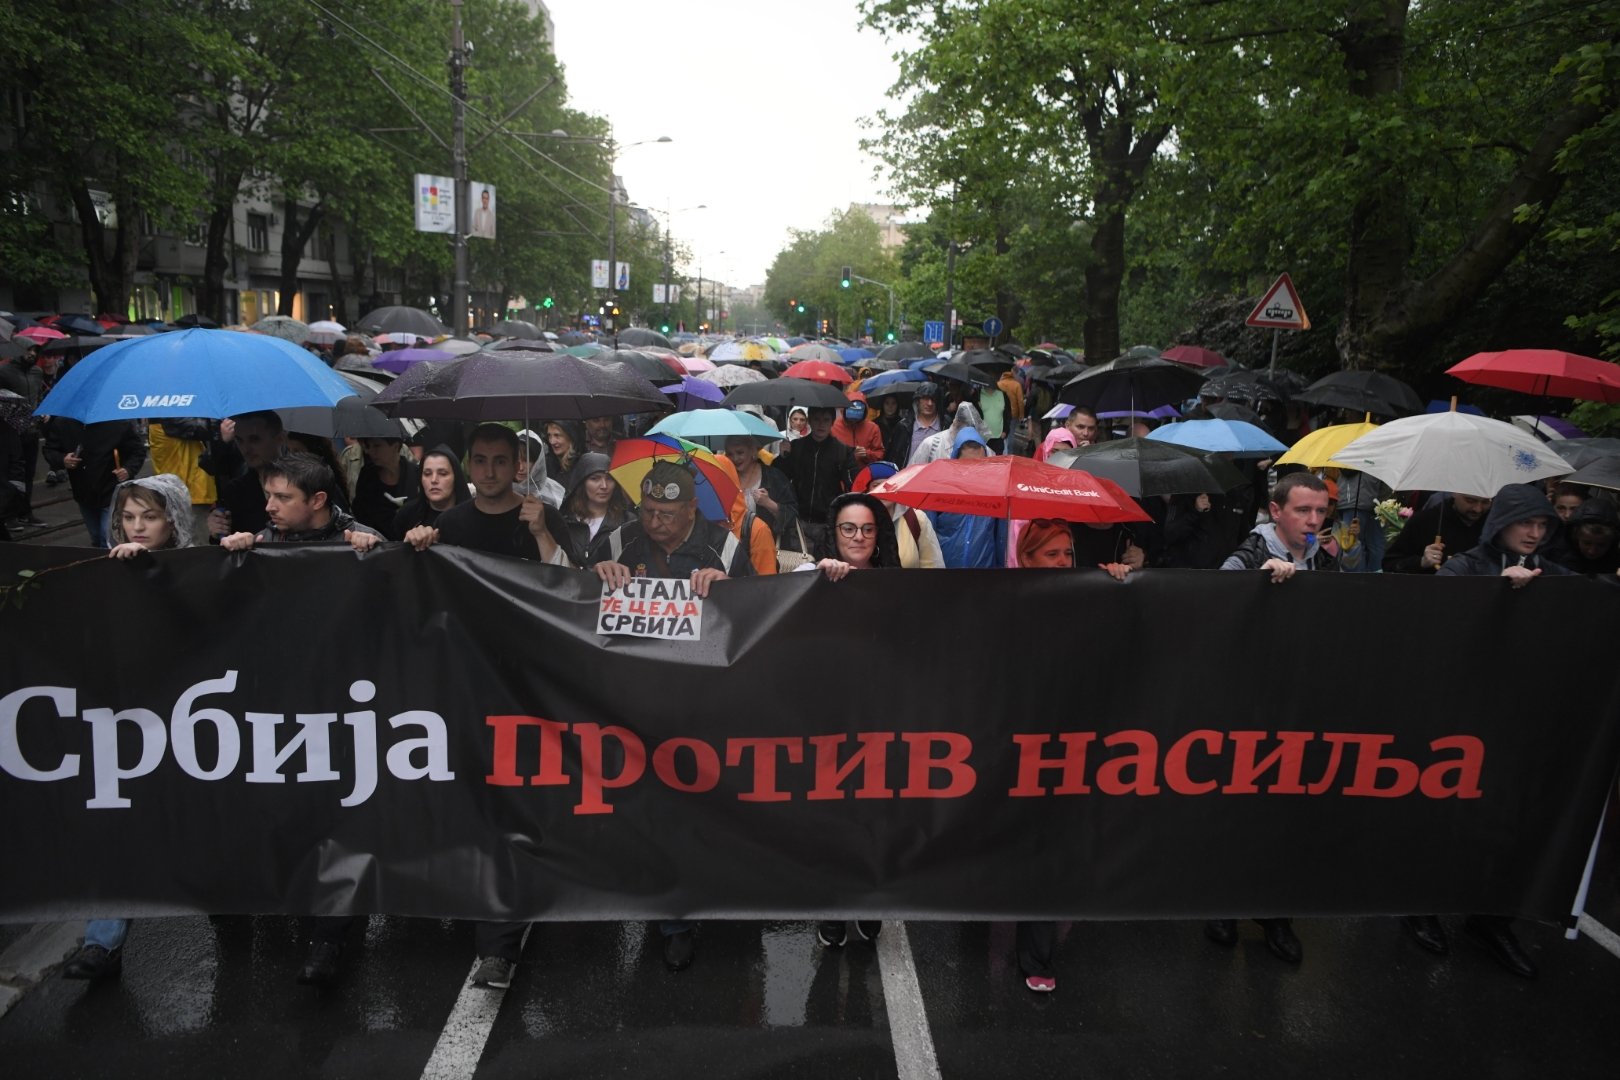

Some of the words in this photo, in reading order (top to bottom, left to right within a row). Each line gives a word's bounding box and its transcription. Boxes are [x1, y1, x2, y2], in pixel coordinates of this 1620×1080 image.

[142, 394, 194, 408] MAPEI
[1028, 485, 1073, 495] UniCredit
[1073, 489, 1100, 498] Bank
[629, 601, 699, 617] ЦЕЛА
[0, 670, 455, 808] Србија
[486, 715, 977, 815] против
[1009, 730, 1485, 799] насиља
